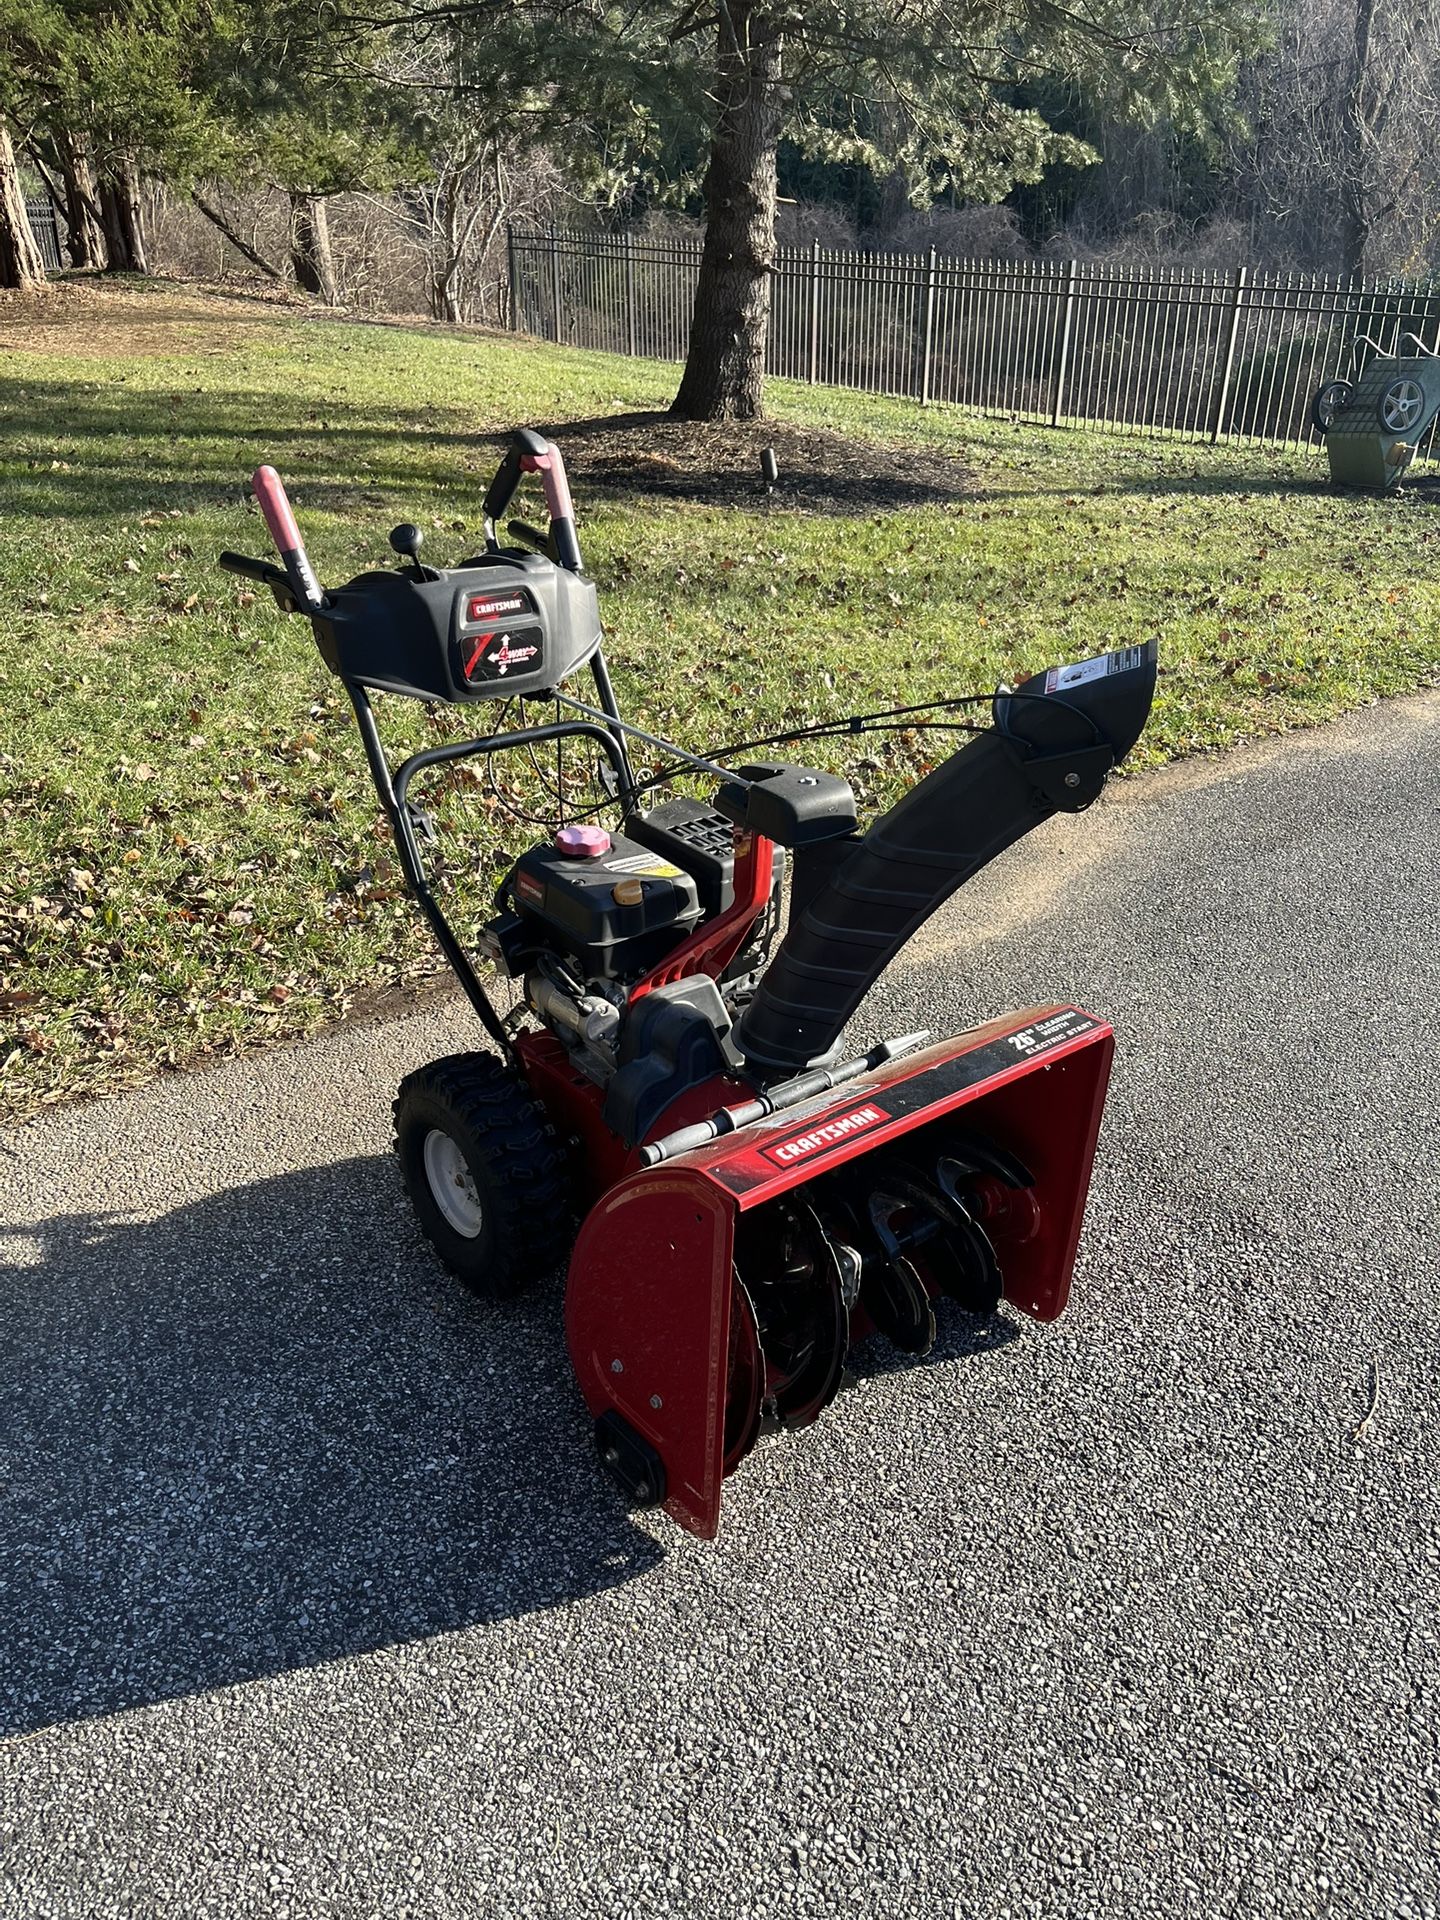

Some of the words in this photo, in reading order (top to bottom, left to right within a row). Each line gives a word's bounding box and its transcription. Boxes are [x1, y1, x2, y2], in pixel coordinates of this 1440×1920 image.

[475, 600, 521, 614] CRAFTSMAN
[1008, 1028, 1036, 1050] 26"
[1035, 1011, 1076, 1032] CLEARING
[1025, 1033, 1067, 1055] ELECTRIC
[1066, 1021, 1093, 1036] START
[1041, 1021, 1070, 1036] WIDTH
[775, 1108, 880, 1160] CRAFTSMAN
